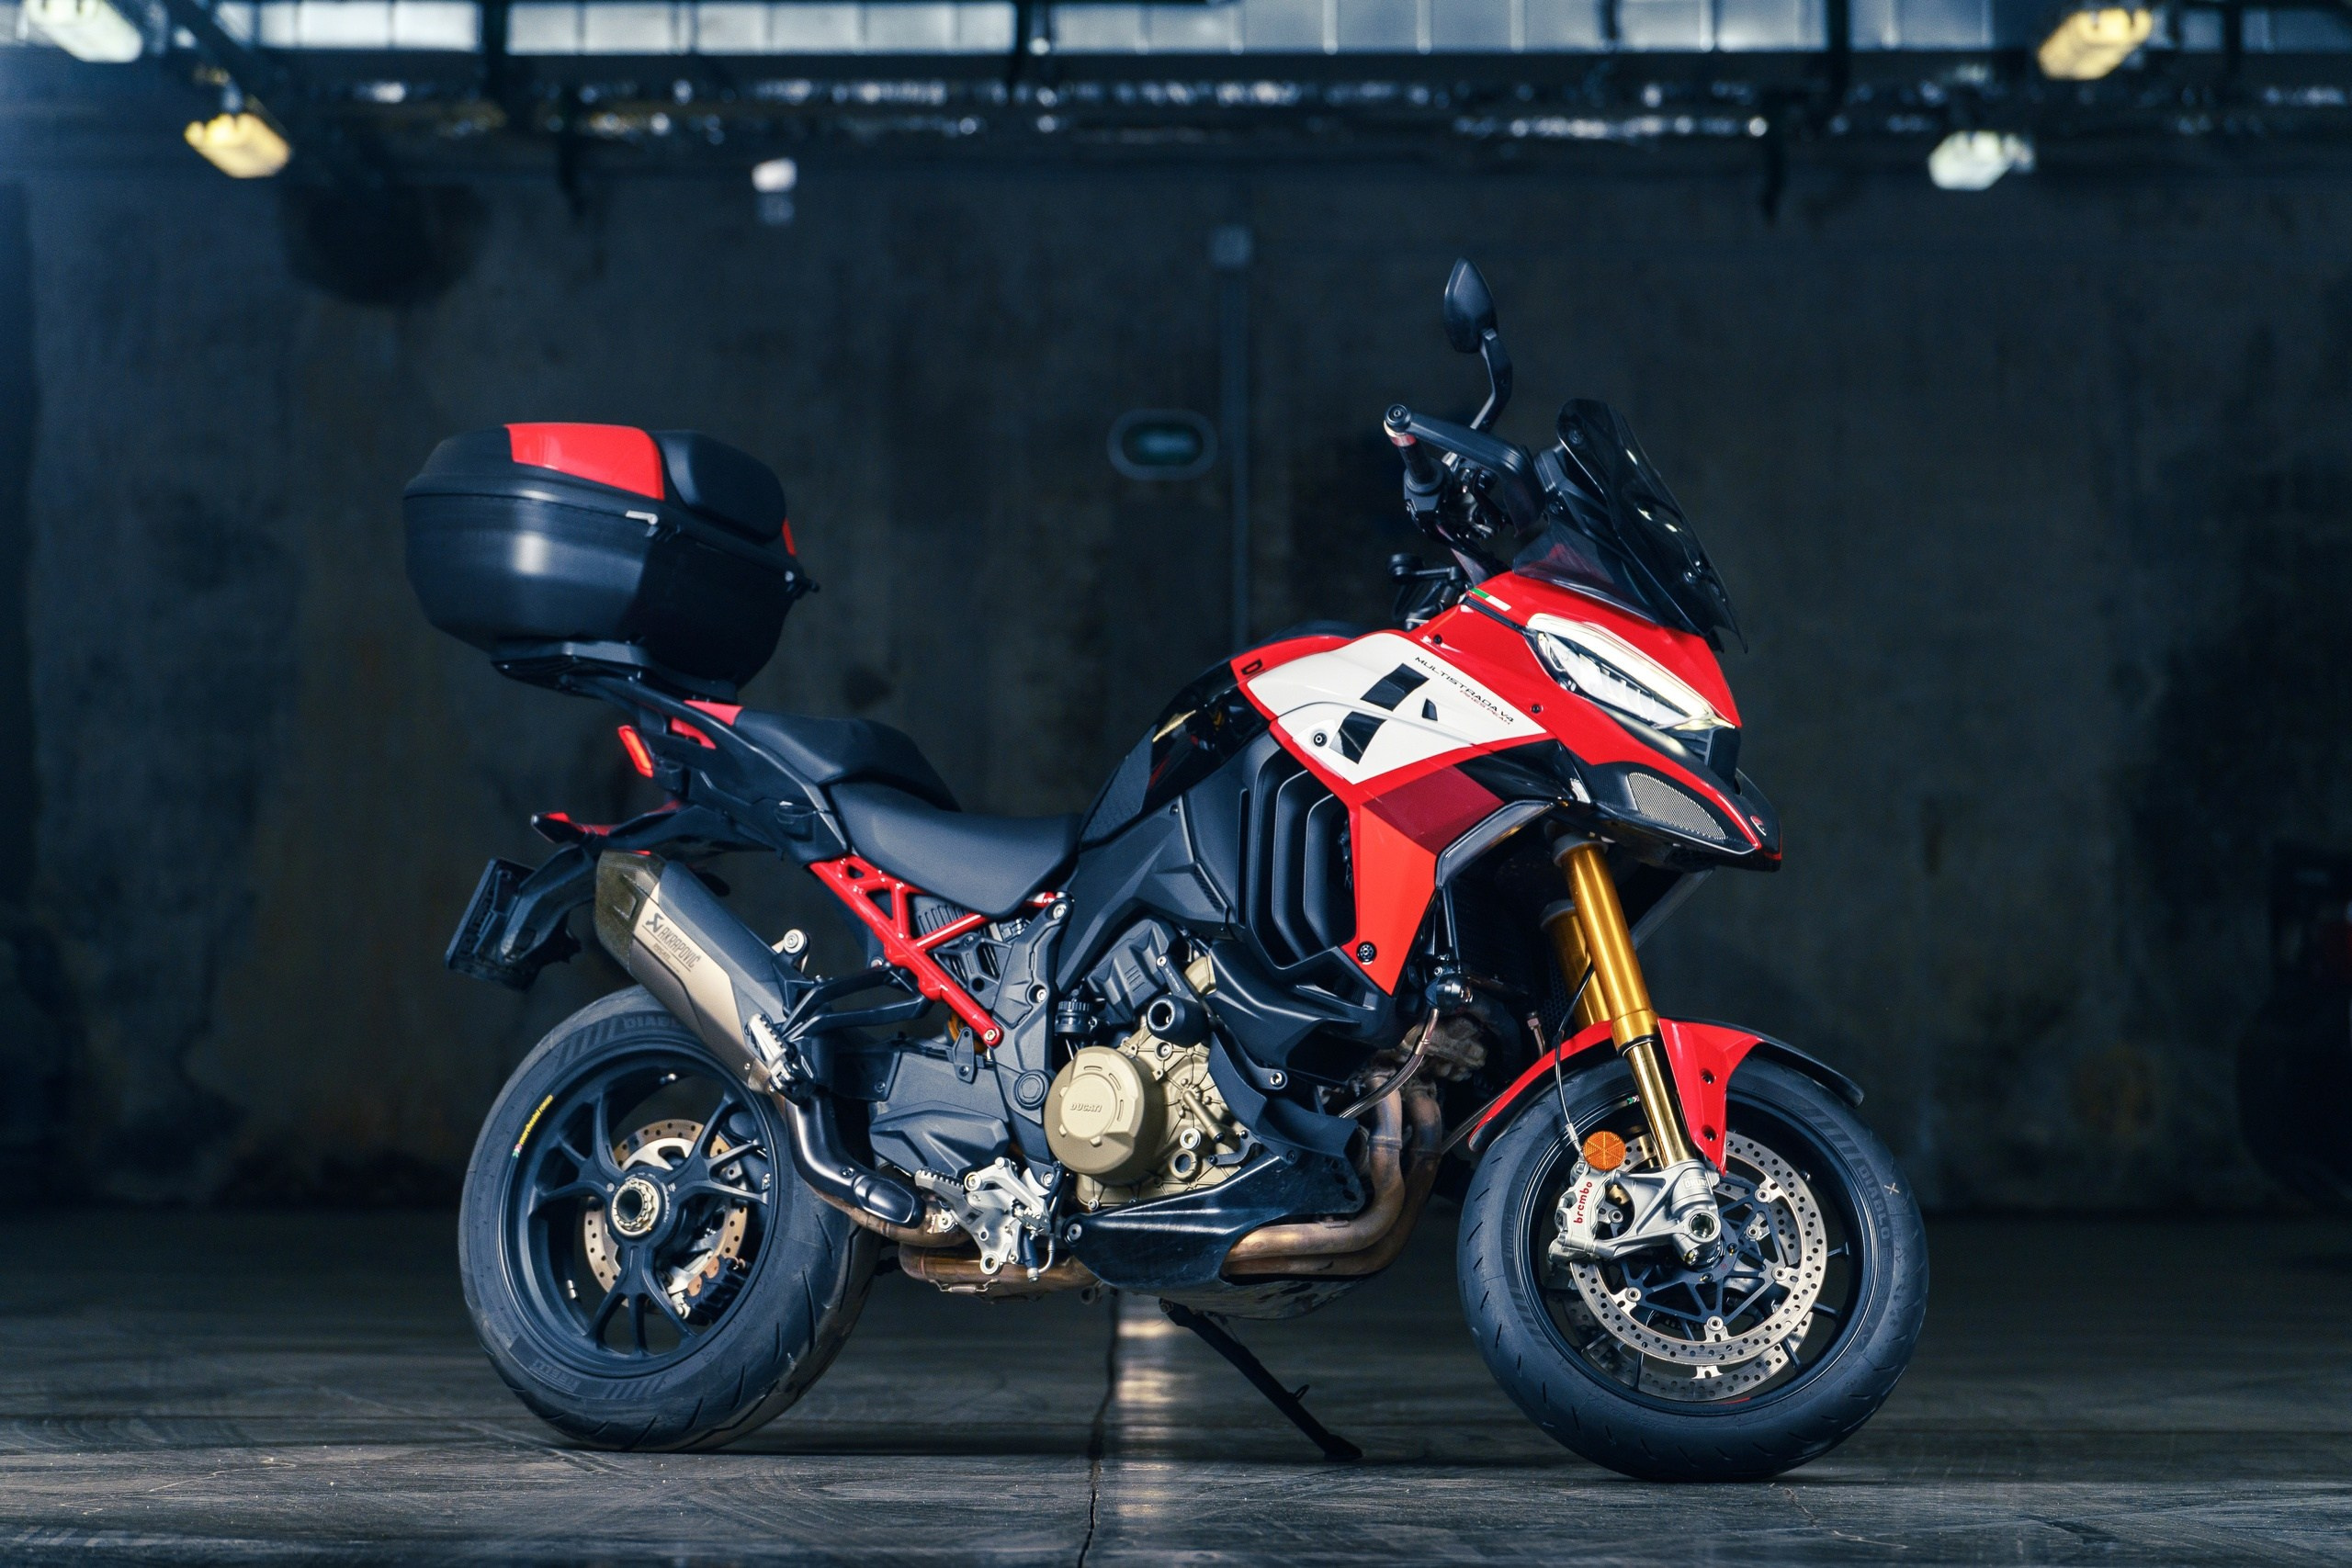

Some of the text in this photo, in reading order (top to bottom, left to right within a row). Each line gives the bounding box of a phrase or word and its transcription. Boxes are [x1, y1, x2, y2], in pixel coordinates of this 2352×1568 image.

[1415, 657, 1514, 723] MULTISTRADA V4
[1069, 1103, 1102, 1112] DUCATI
[1574, 1181, 1592, 1224] brembo
[1857, 1164, 1890, 1239] DIABLO
